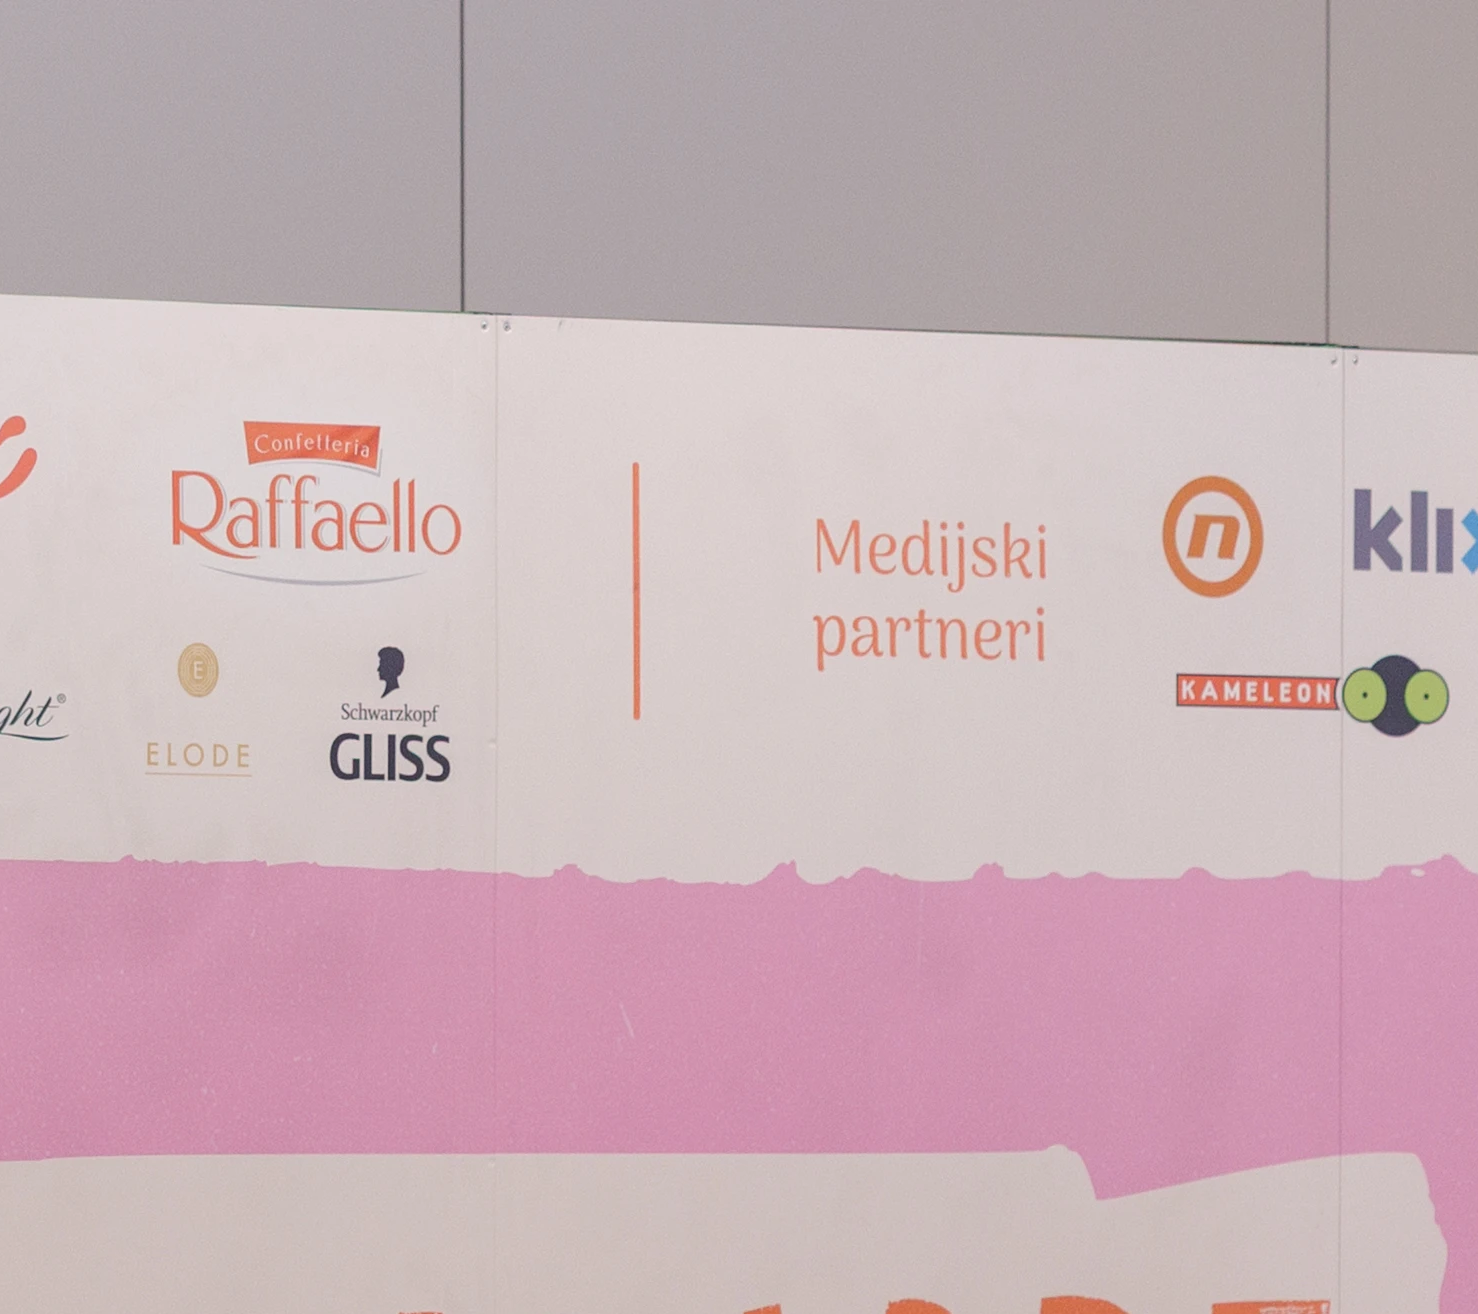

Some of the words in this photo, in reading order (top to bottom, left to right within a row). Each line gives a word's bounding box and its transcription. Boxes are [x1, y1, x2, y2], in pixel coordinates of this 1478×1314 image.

[253, 432, 371, 460] Confetteria
[171, 469, 463, 561] Raffaello
[814, 516, 1047, 594] Medijski
[813, 606, 1046, 672] partneri
[1180, 678, 1332, 705] KAMELEON
[341, 703, 440, 727] Schwarzkopf
[146, 742, 250, 768] ELODE
[329, 732, 451, 782] GLISS
